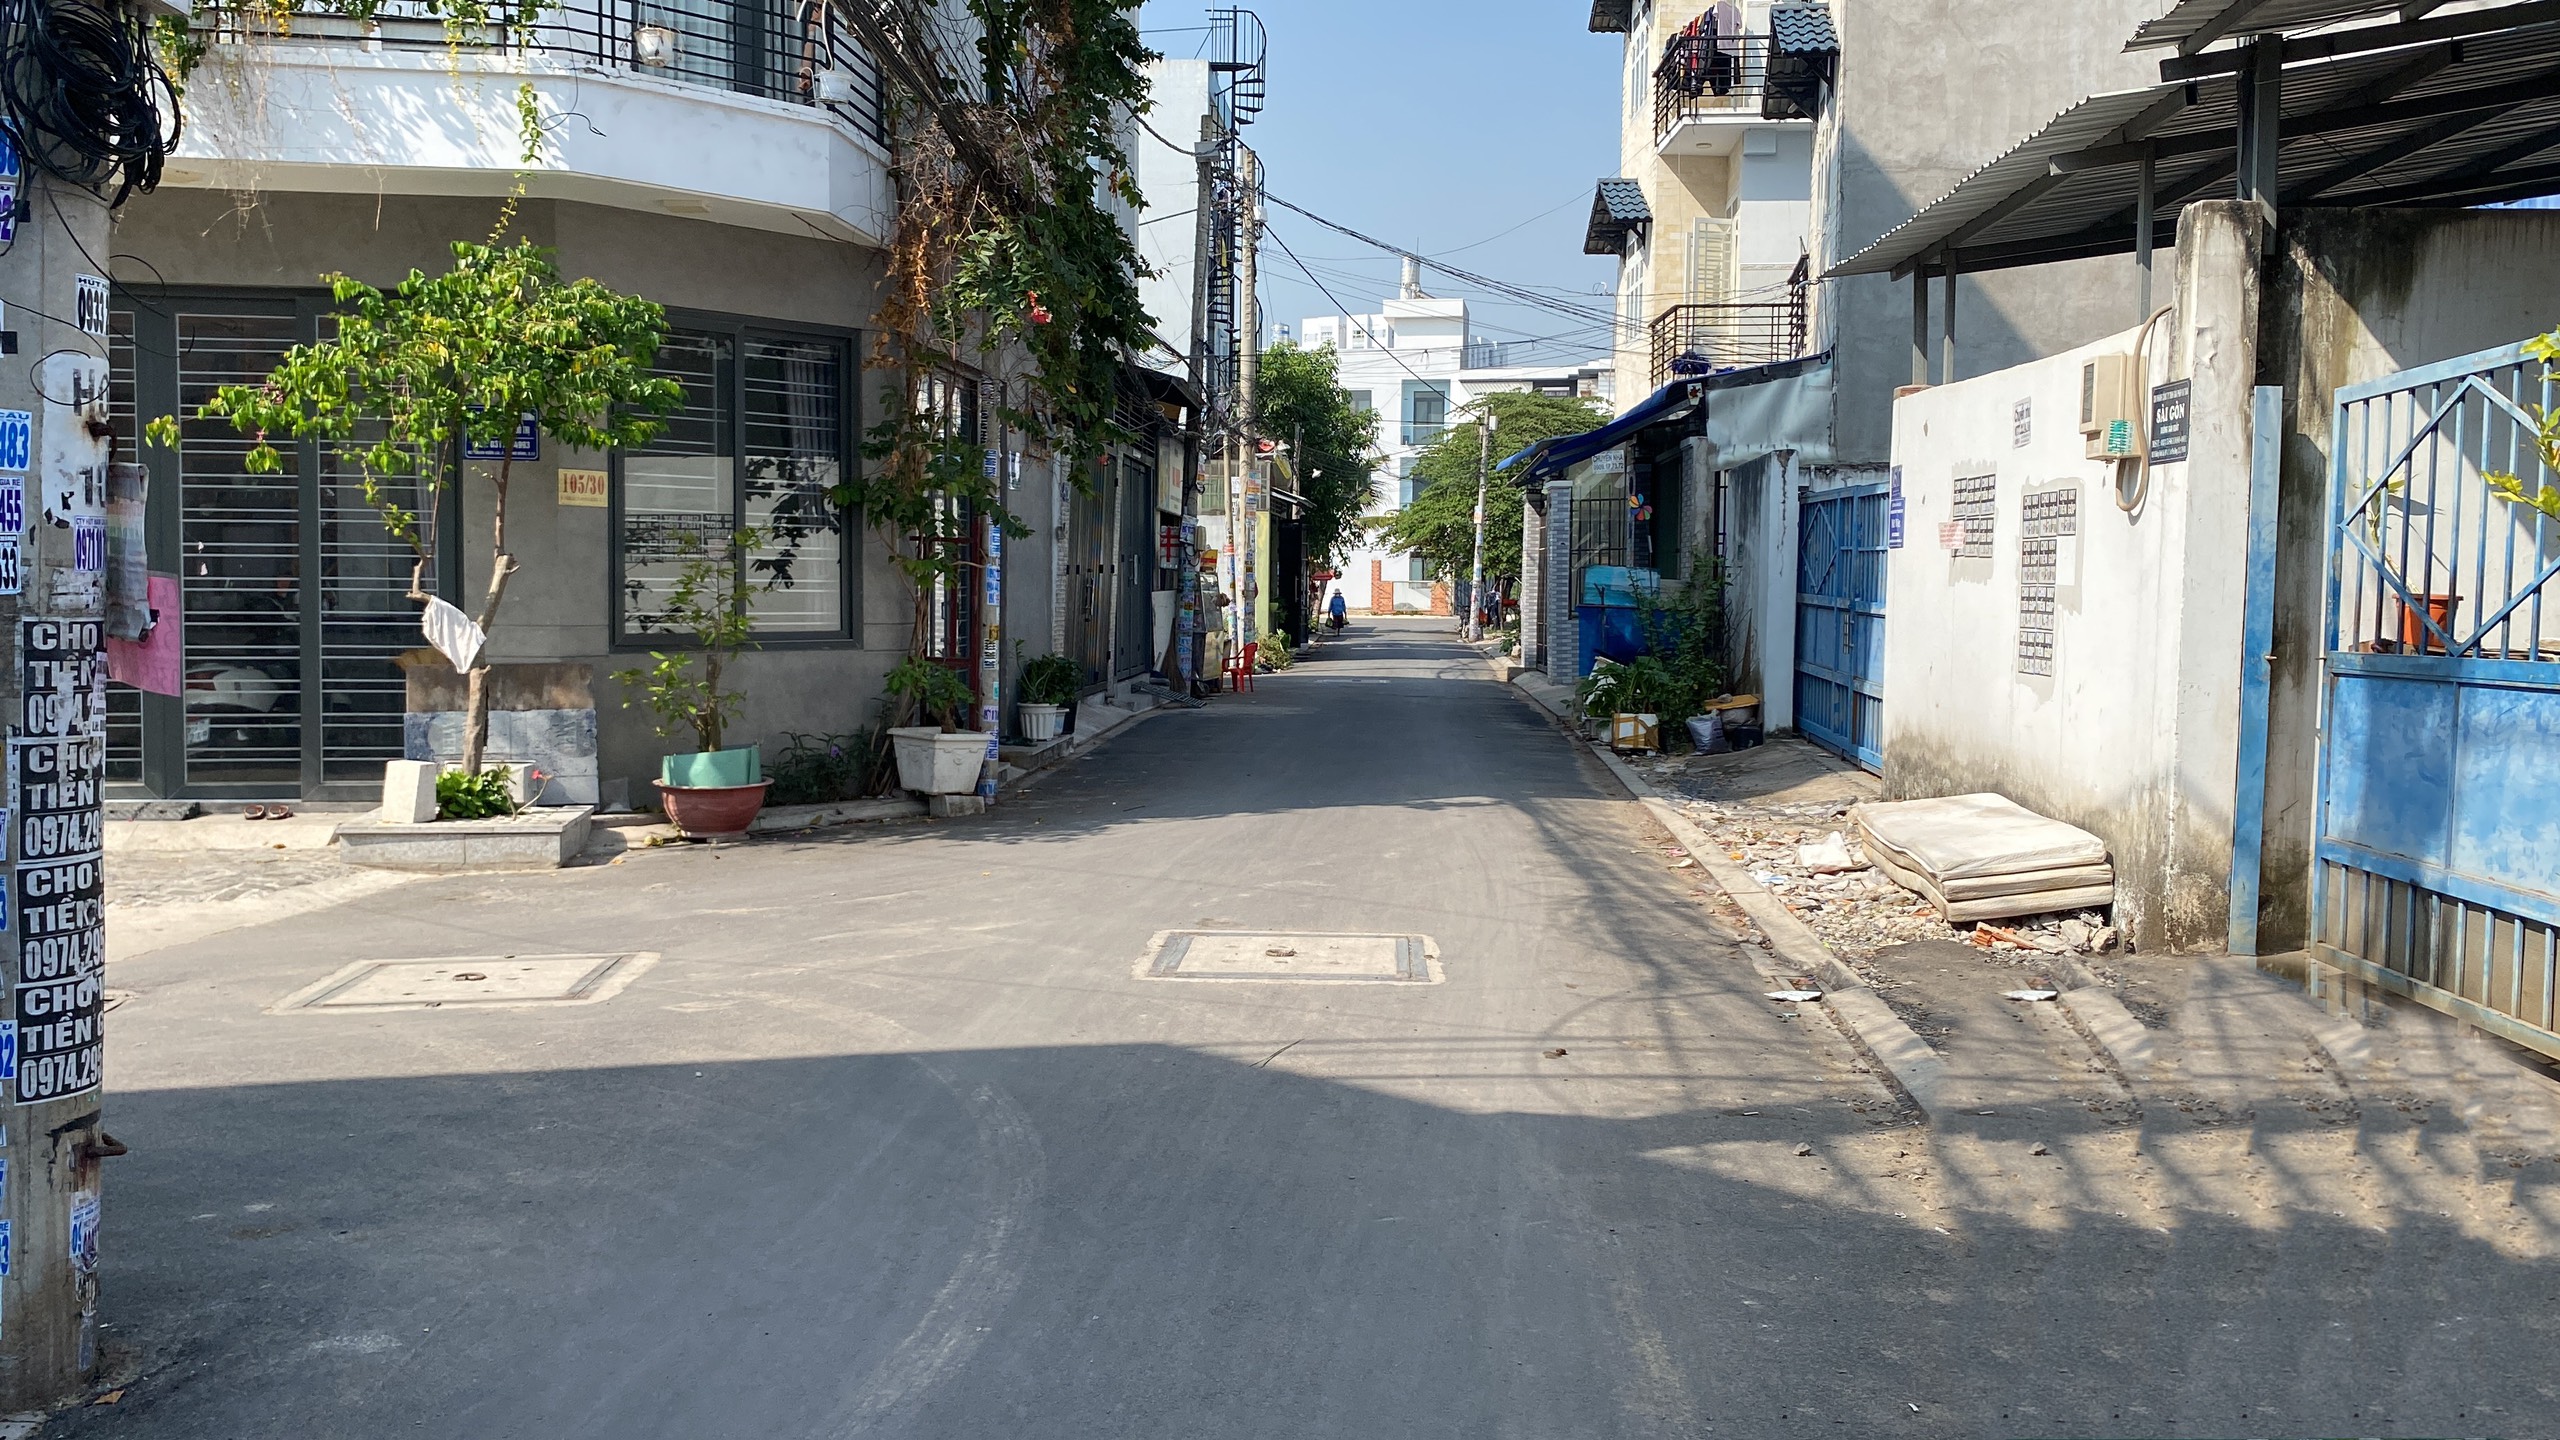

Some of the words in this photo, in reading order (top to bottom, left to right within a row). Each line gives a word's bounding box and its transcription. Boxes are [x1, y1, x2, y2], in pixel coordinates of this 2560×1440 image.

[563, 473, 604, 495] 105/30
[0, 547, 18, 589] 33
[32, 623, 98, 650] CHO
[26, 772, 95, 810] TIỀN
[26, 863, 93, 897] CHO
[25, 982, 93, 1016] CHO
[21, 1012, 92, 1053] TIỀN
